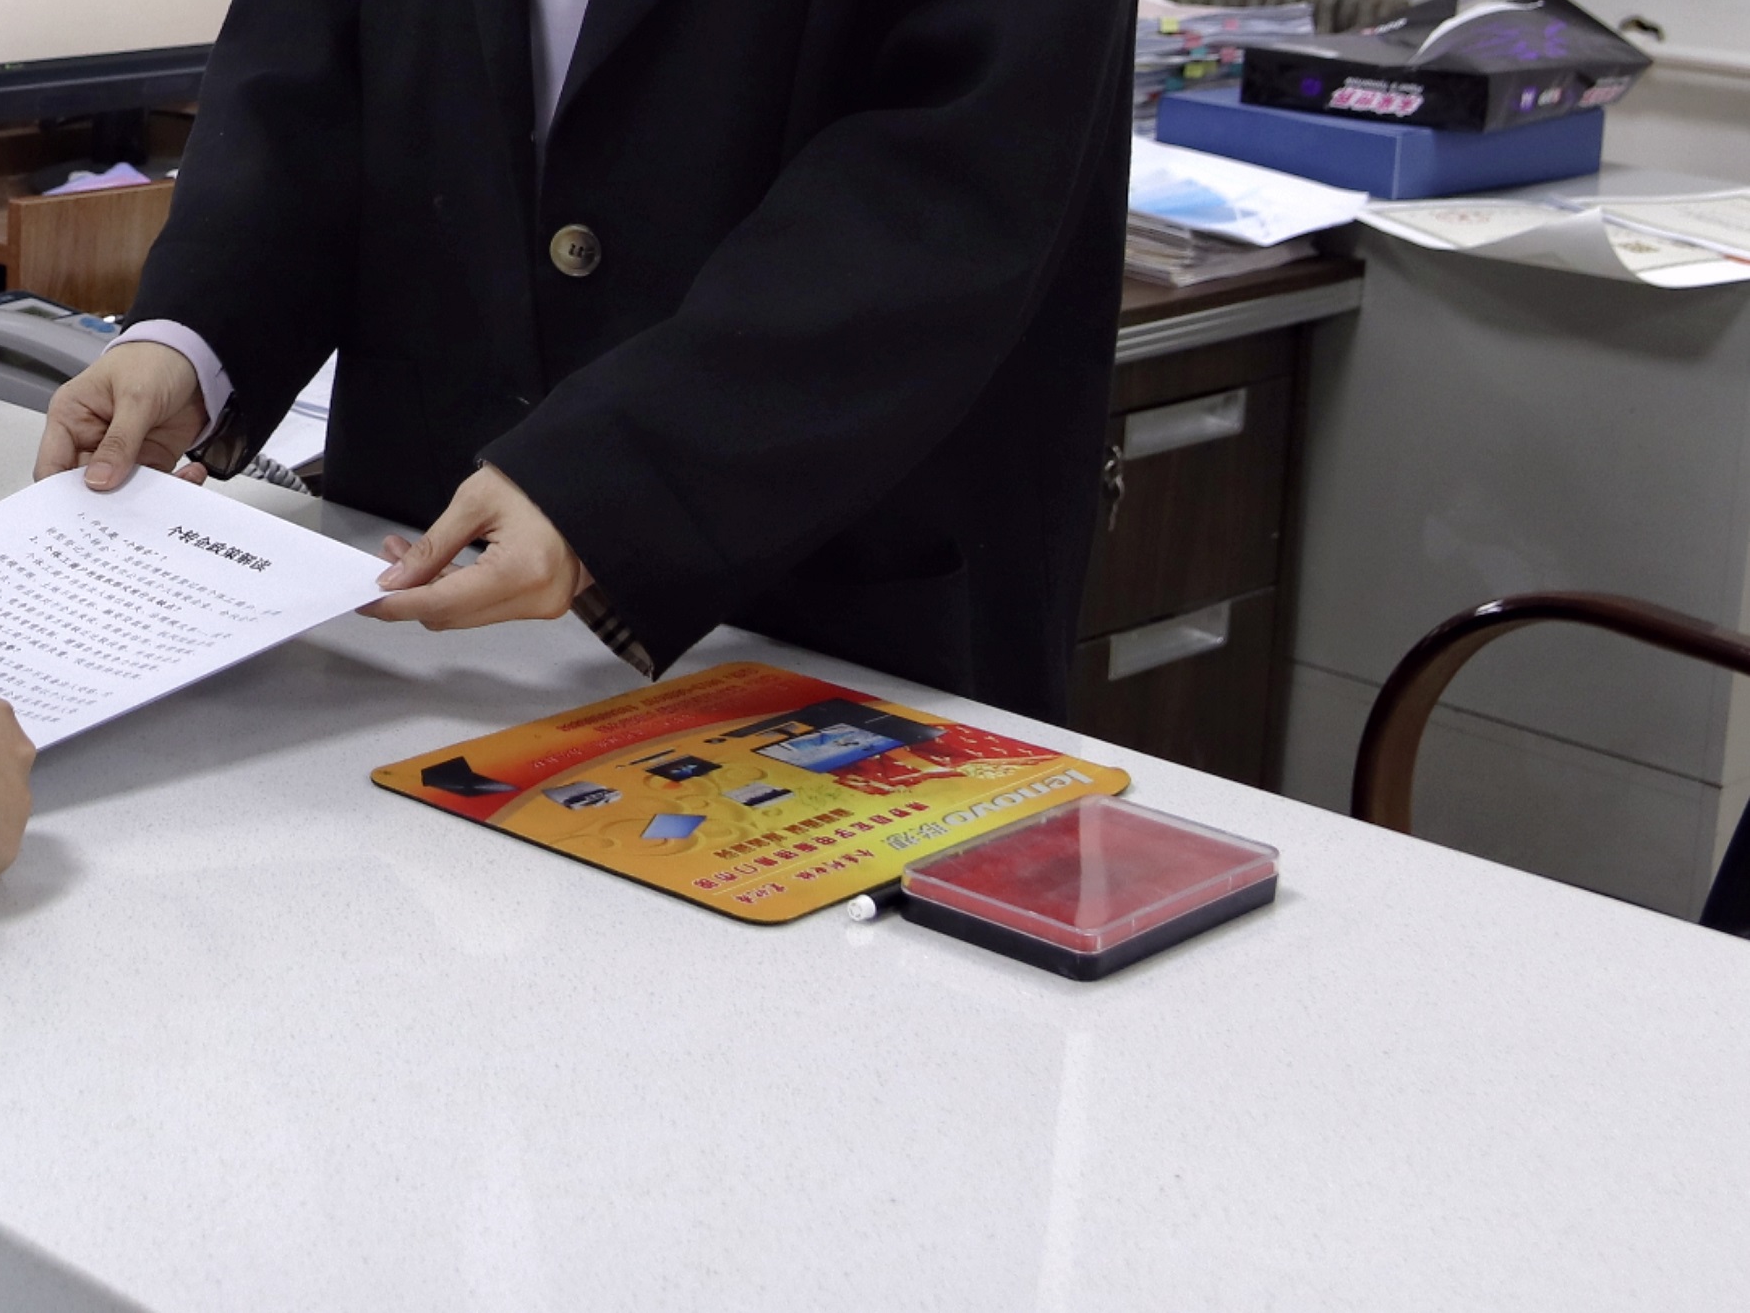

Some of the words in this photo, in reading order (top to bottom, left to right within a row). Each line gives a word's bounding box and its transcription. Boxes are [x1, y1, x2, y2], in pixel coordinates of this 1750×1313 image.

[167, 525, 272, 572] 个转企政策解读
[942, 768, 1095, 829] lenovo
[881, 813, 949, 852] 联想
